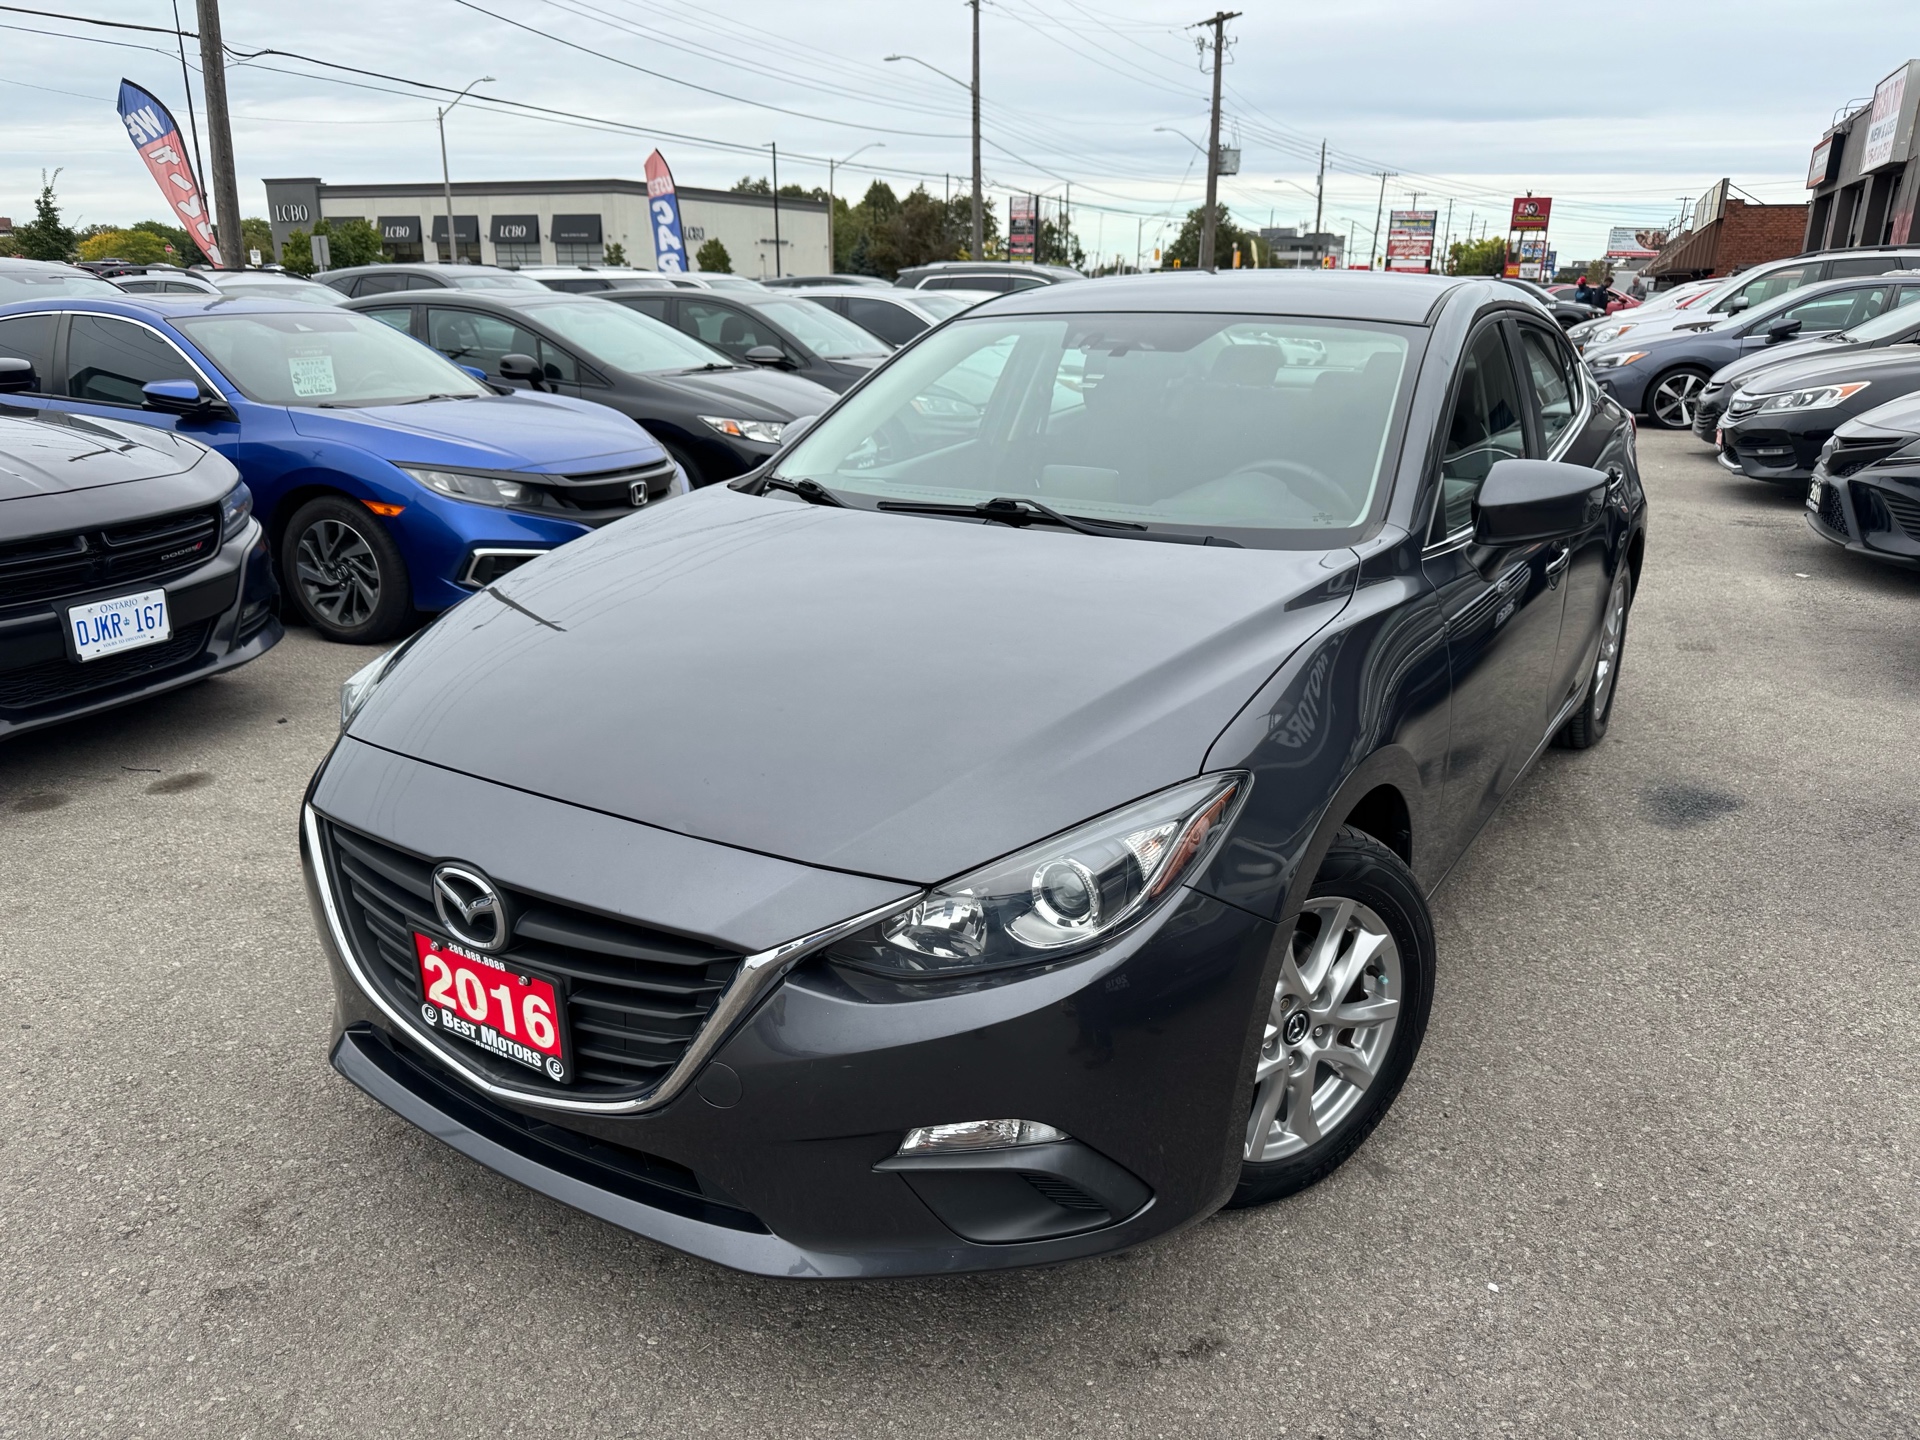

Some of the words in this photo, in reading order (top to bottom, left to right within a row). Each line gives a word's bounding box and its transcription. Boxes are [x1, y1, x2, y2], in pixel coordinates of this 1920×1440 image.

[275, 204, 309, 222] LCBO
[385, 226, 410, 238] LCBO
[500, 225, 527, 238] LCBO
[161, 544, 198, 560] DODGE
[100, 599, 138, 613] ONTARIO
[76, 613, 123, 646] DJKR
[135, 603, 163, 633] 167
[125, 633, 147, 643] DISCOVER
[424, 954, 555, 1049] 2016
[441, 1008, 477, 1039] BEST
[481, 1025, 542, 1067] MOTORS
[475, 1038, 508, 1059] Hamilton
